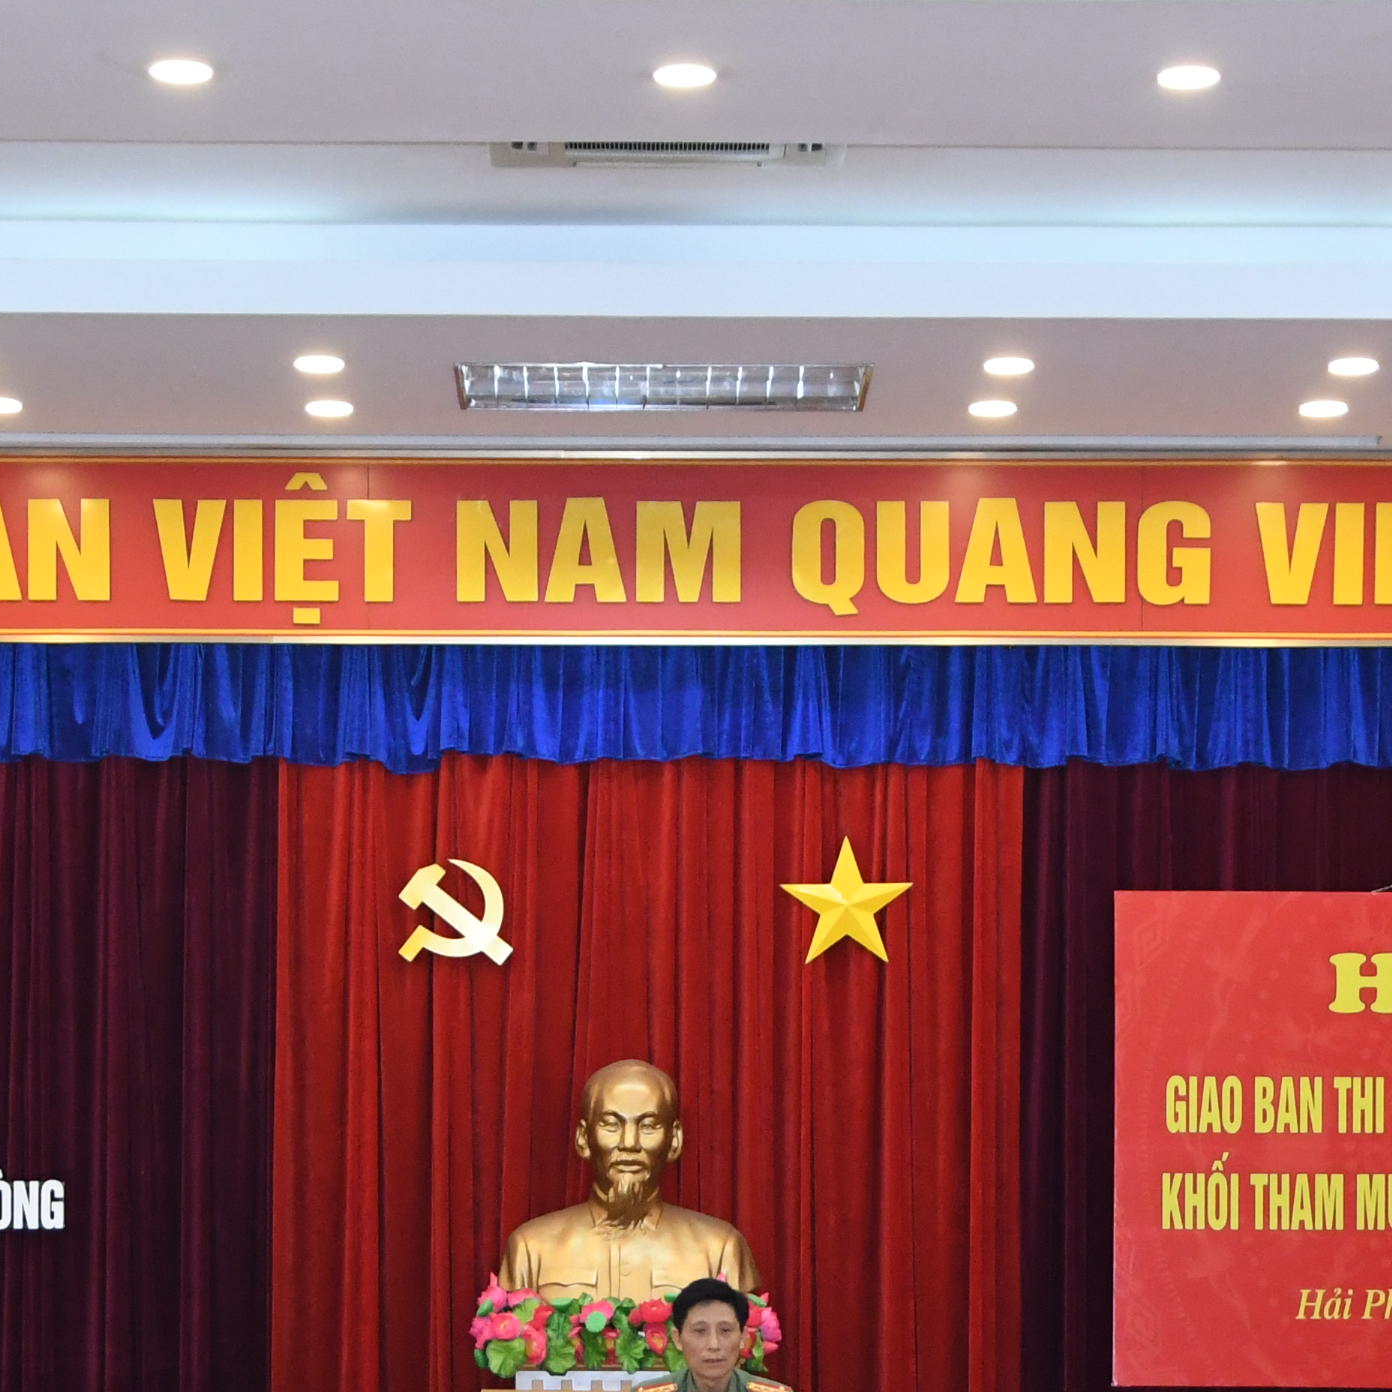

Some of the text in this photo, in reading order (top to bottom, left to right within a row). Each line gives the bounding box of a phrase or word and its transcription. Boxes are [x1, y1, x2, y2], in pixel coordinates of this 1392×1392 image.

[155, 472, 413, 626] VIỆT
[457, 499, 742, 605] NAM
[792, 501, 1212, 617] QUANG
[1166, 1075, 1242, 1134] GIAO
[1255, 1077, 1322, 1133] BAN
[1334, 1077, 1384, 1133] THI
[1162, 1152, 1238, 1230] KHỐI
[1250, 1174, 1344, 1230] THAM
[1296, 1288, 1353, 1320] Hải
